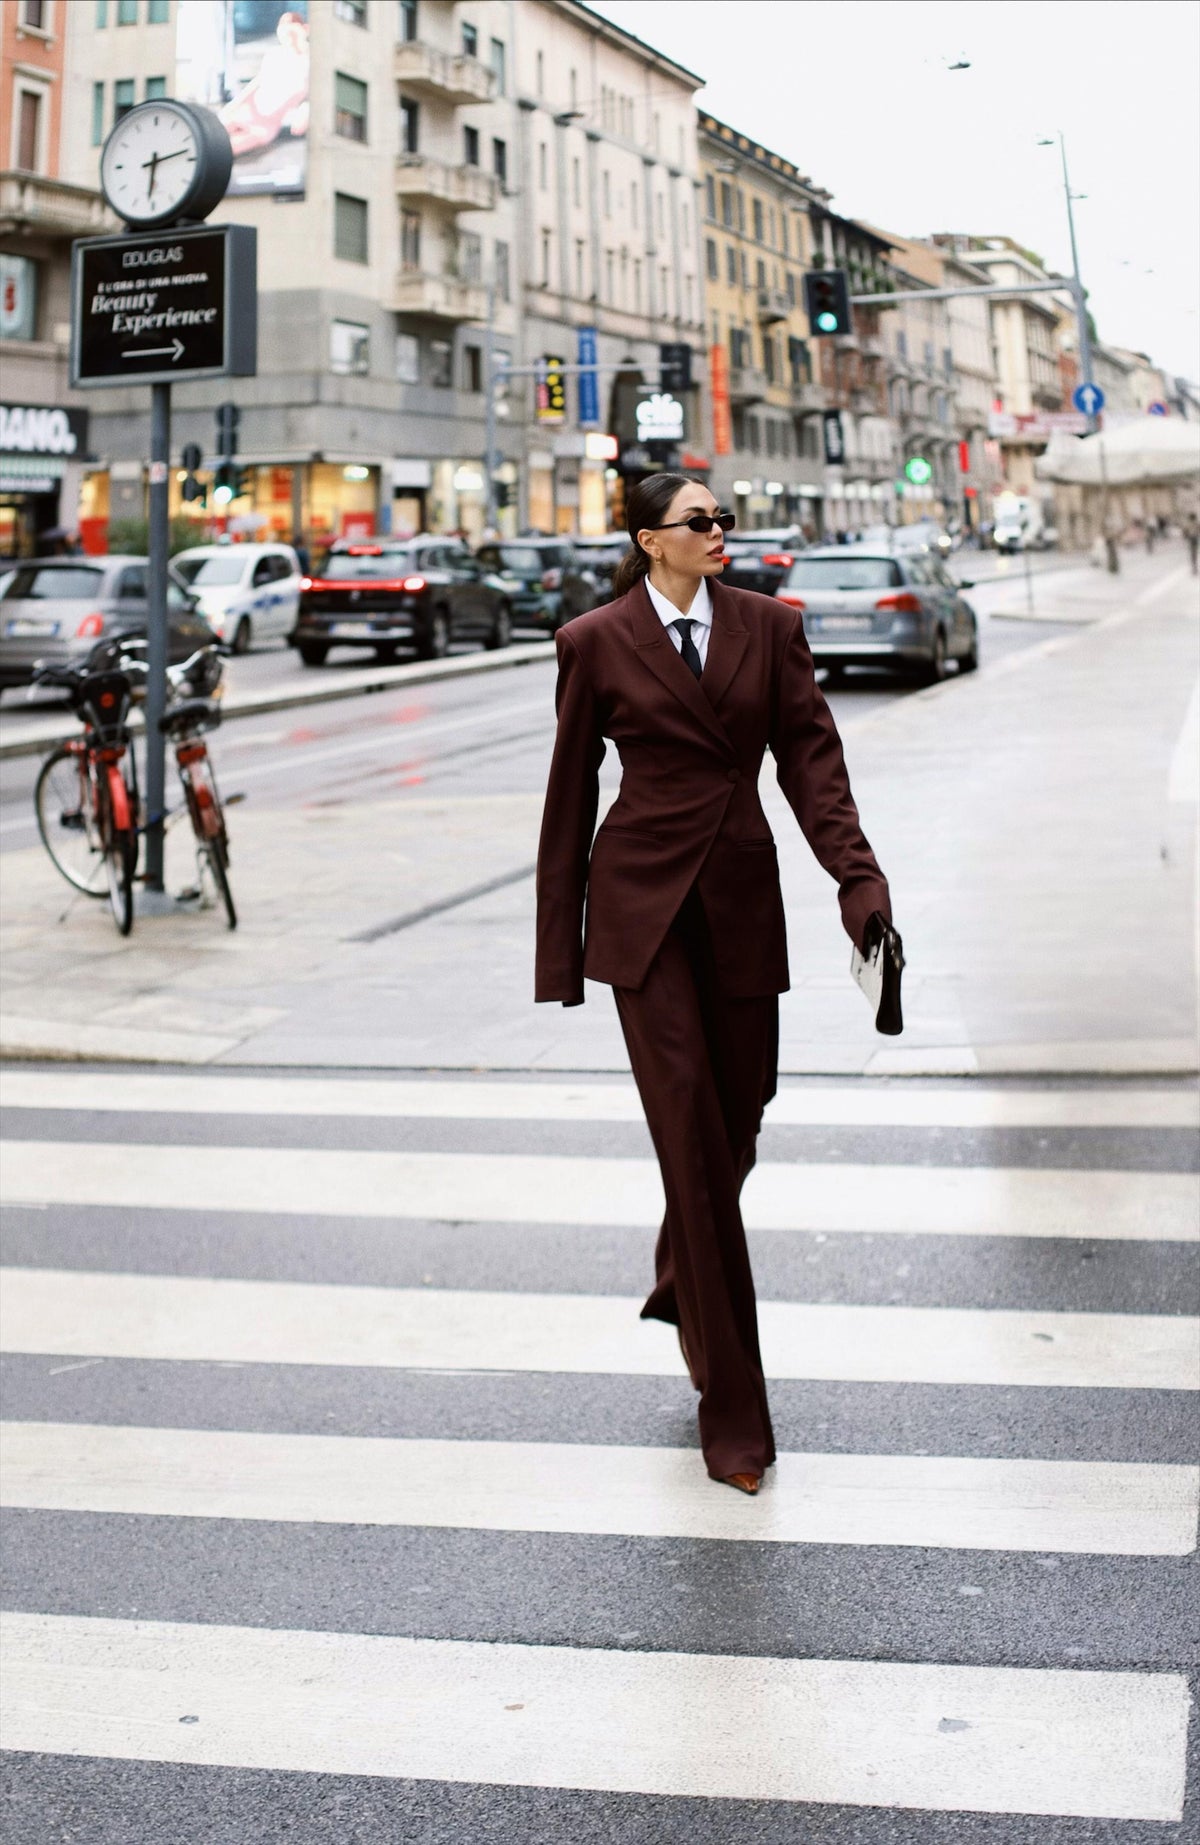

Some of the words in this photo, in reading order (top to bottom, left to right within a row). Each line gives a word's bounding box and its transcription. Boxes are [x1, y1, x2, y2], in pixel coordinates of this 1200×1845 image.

[122, 246, 184, 268] DOUGLAS
[135, 278, 147, 290] DI
[148, 276, 170, 288] UNA
[171, 272, 208, 285] NUOVA
[91, 292, 159, 315] Beauty
[111, 307, 218, 336] Experience
